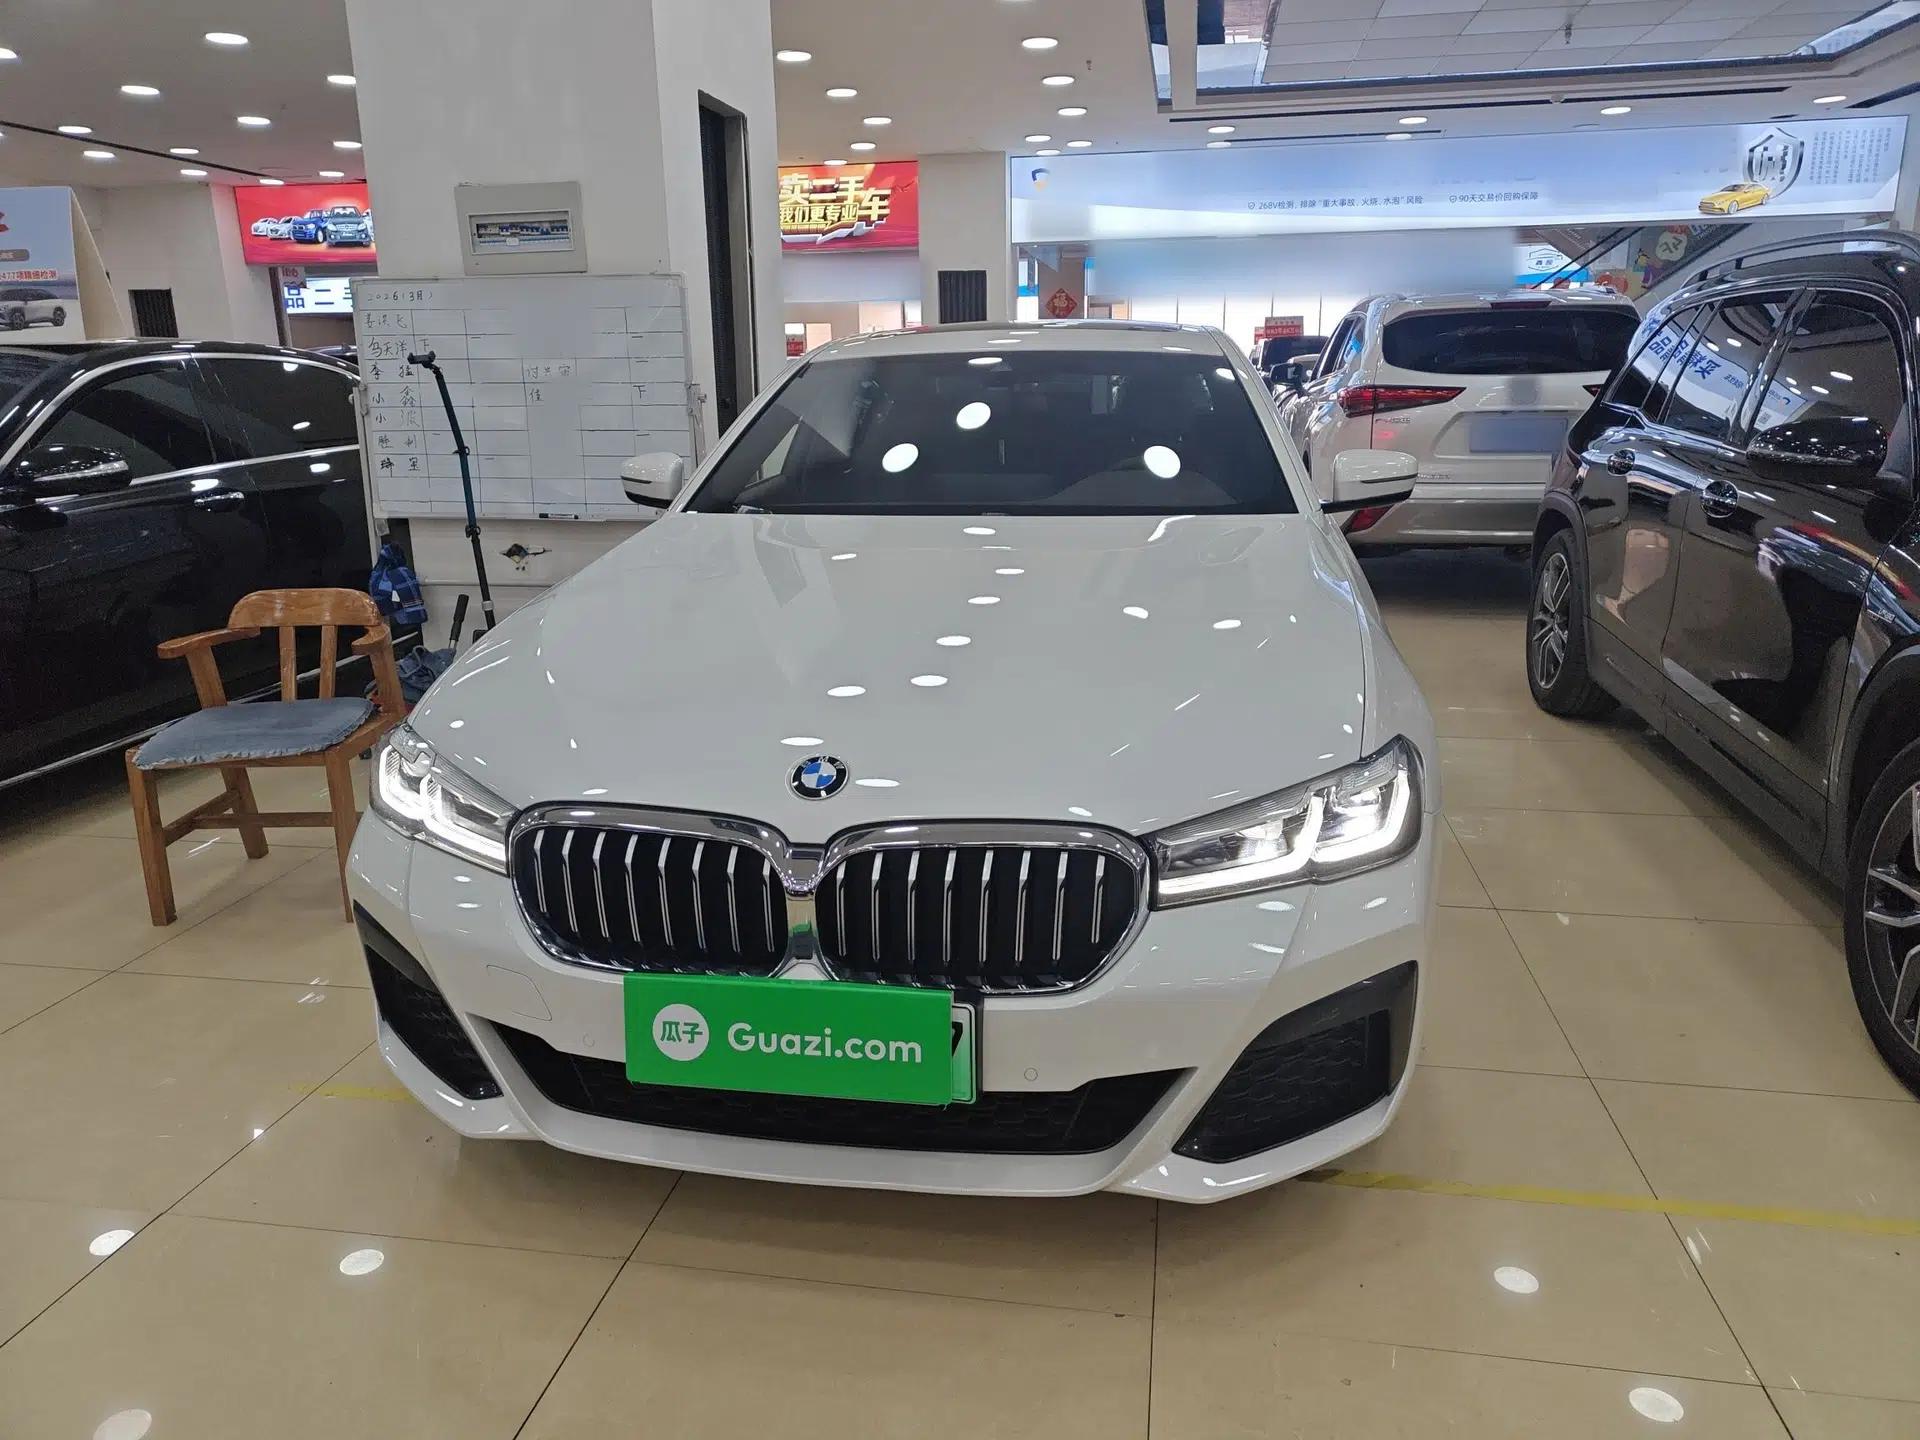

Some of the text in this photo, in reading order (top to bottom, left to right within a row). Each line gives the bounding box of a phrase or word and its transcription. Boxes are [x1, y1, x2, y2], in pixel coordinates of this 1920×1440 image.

[779, 173, 892, 221] 卖二手车
[780, 205, 858, 223] 我们更专业
[660, 1020, 703, 1043] 瓜子
[727, 1022, 922, 1064] Guazi.com
